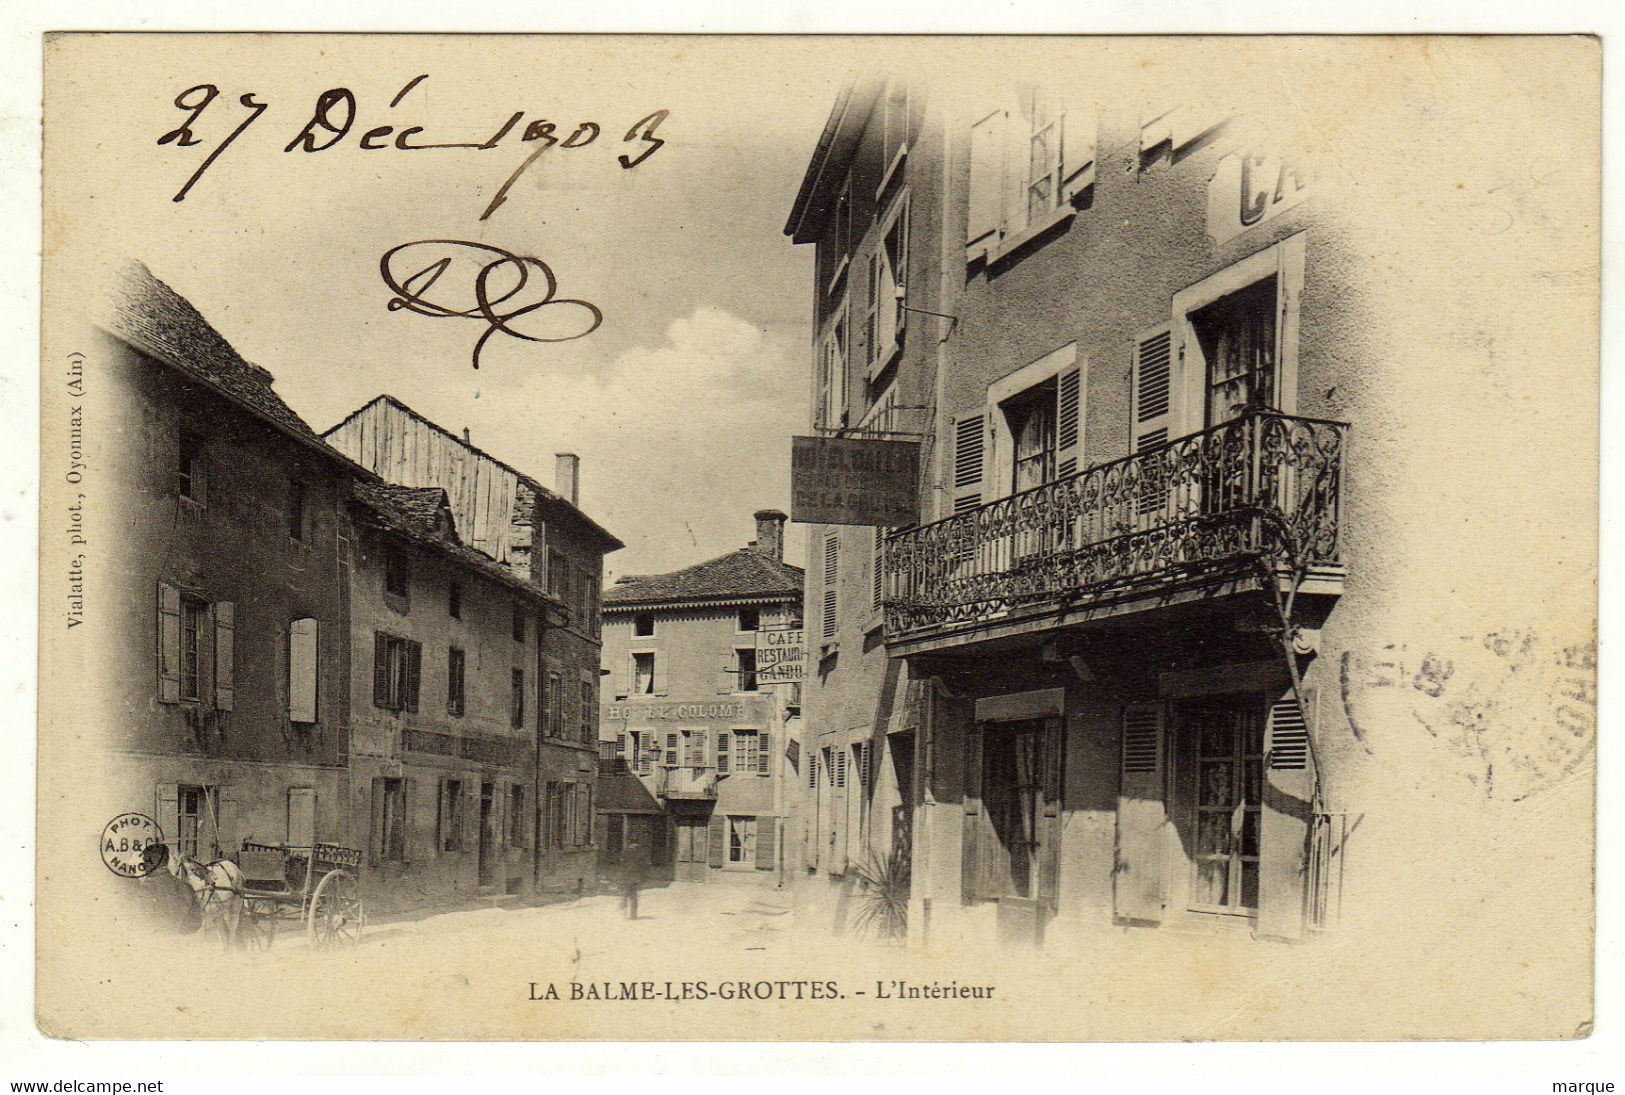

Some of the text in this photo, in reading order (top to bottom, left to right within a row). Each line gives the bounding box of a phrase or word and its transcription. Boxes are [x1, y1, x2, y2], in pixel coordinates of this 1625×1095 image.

[157, 83, 268, 203] 27
[478, 108, 670, 222] 1903
[110, 856, 152, 874] NANC
